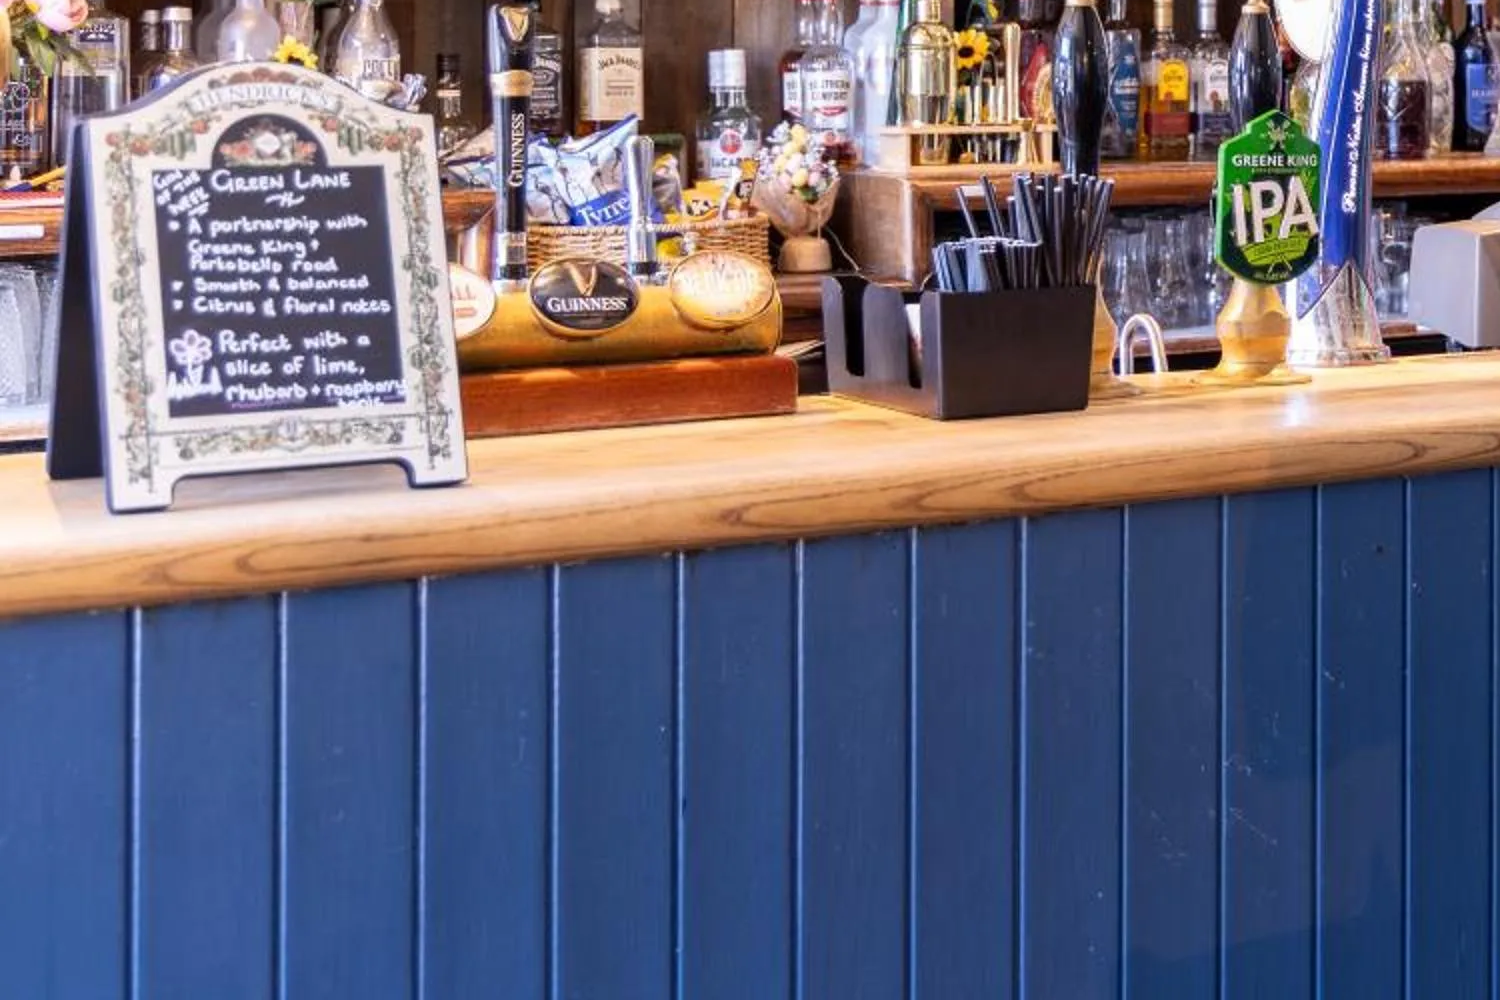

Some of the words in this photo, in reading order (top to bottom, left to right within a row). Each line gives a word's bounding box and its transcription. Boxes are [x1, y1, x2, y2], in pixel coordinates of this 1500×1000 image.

[508, 112, 525, 188] GUINNESS
[1231, 153, 1284, 167] GREENE
[1286, 152, 1318, 167] KING
[293, 170, 352, 190] LANE
[575, 196, 632, 226] Tyrre
[1232, 175, 1320, 247] IPA
[187, 217, 203, 235] A
[209, 214, 320, 239] partnership
[326, 214, 368, 230] with
[187, 238, 256, 256] Greene
[260, 239, 307, 259] King
[188, 254, 283, 273] Portobello
[292, 256, 340, 273] road
[193, 276, 262, 293] Smooth
[287, 274, 371, 291] balanced
[192, 296, 257, 315] Citrus
[283, 296, 336, 315] floral
[341, 296, 393, 314] notes
[547, 296, 628, 314] GUINNESS
[218, 328, 293, 355] Perfect
[303, 329, 348, 350] with
[357, 334, 371, 347] a
[225, 358, 273, 378] slice
[226, 382, 308, 403] rhubarb
